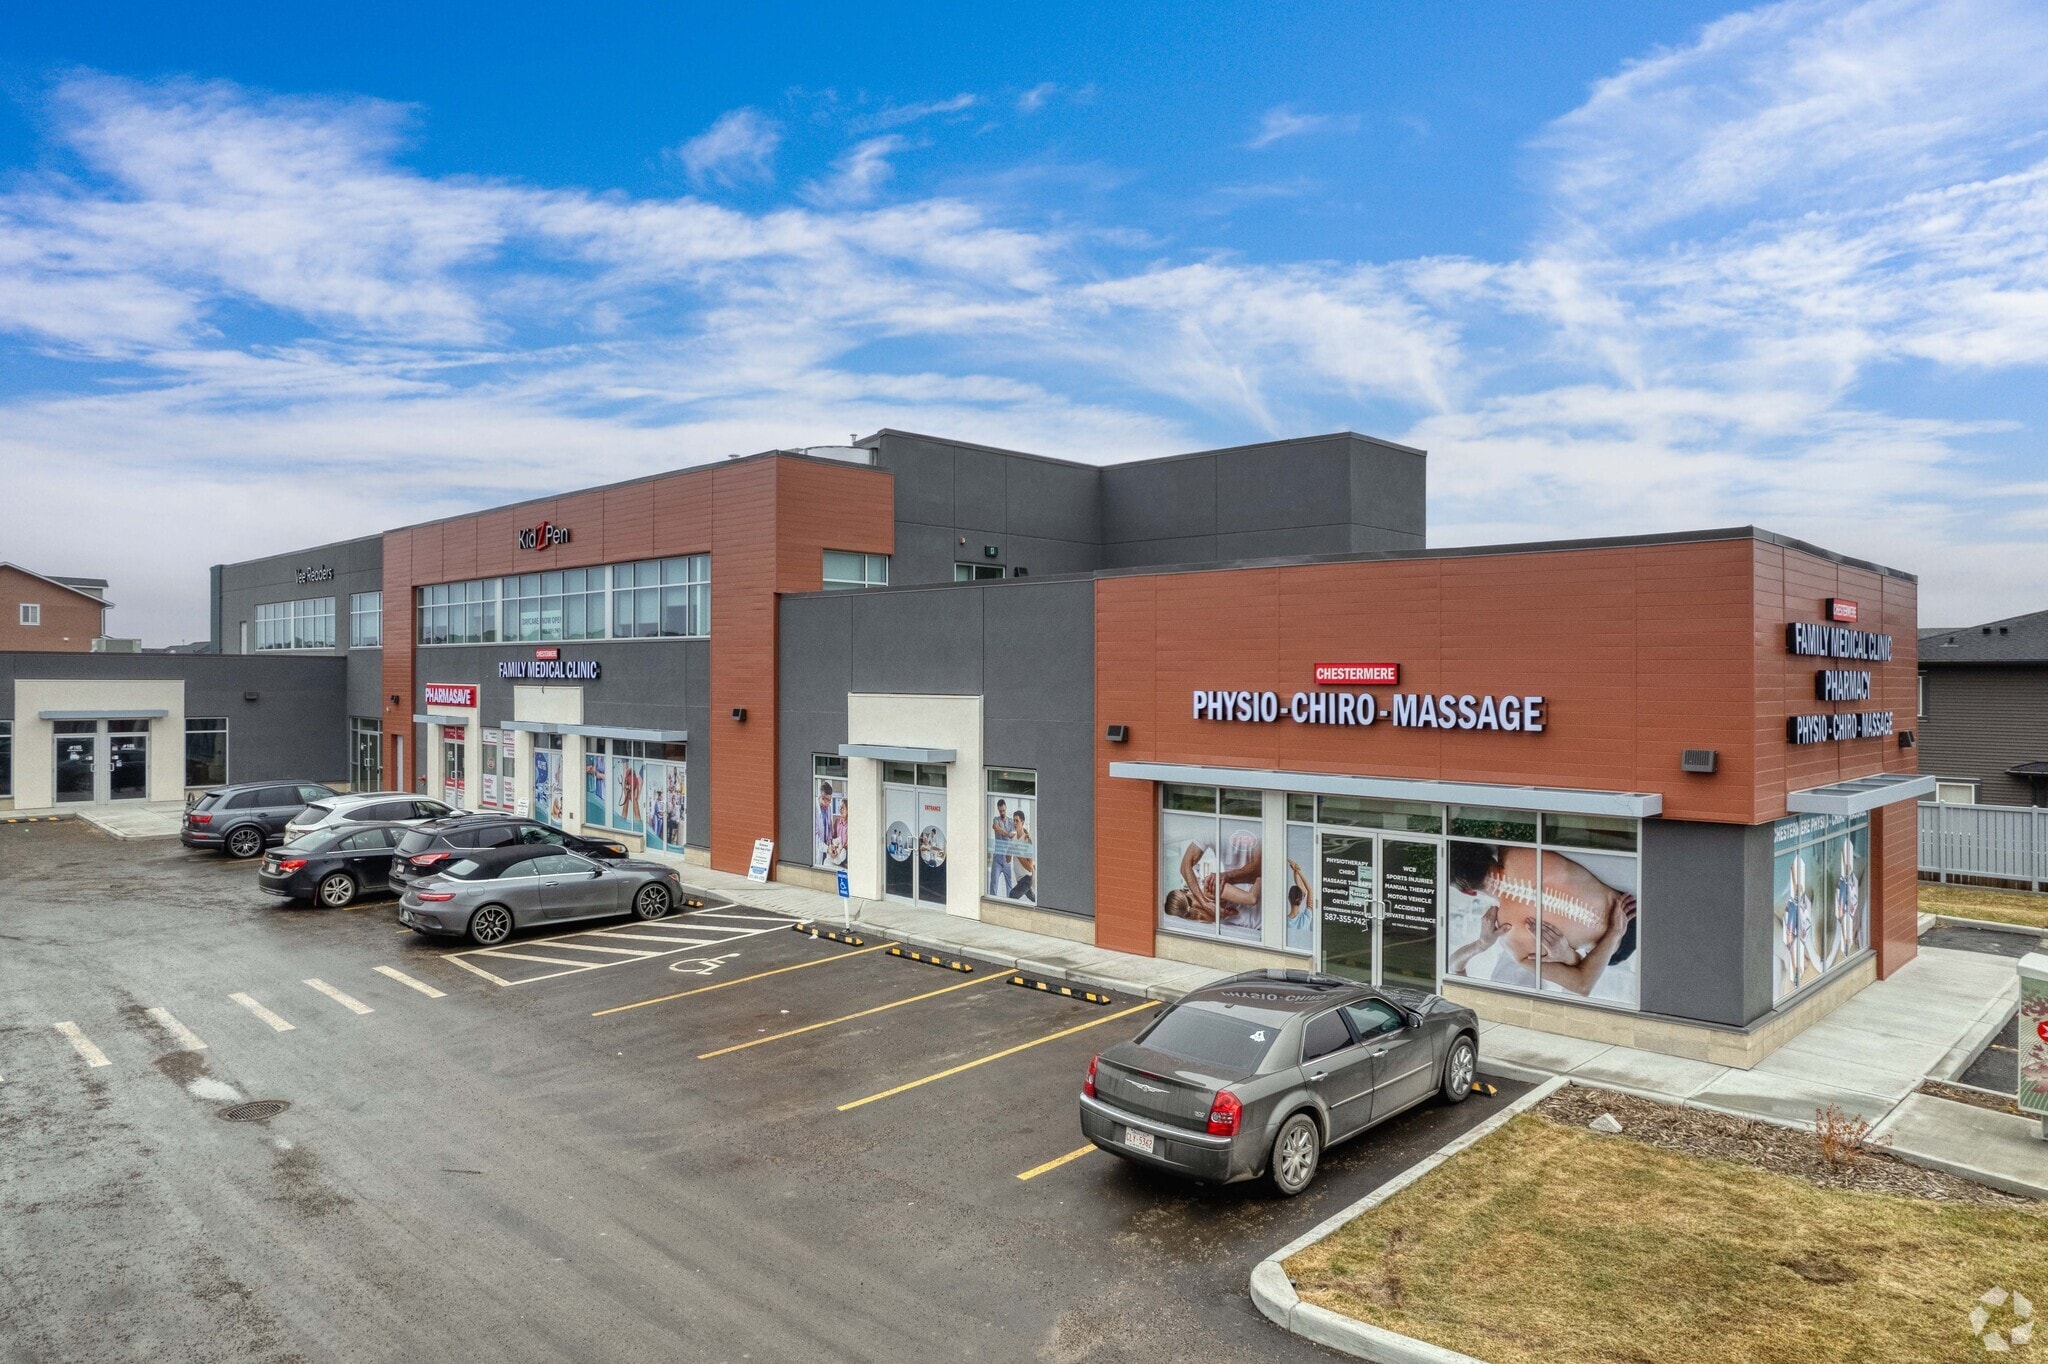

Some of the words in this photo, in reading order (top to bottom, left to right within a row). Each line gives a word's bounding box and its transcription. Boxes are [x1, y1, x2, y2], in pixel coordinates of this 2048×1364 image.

[1795, 623, 1830, 655] FAMILY
[1831, 627, 1868, 660] MEDICAL
[1868, 633, 1892, 662] CLINIC
[499, 661, 526, 678] FAMILY
[527, 661, 565, 678] MEDICAL
[566, 661, 597, 679] CLINIC
[1316, 667, 1395, 680] CHESTERMERE
[1825, 670, 1871, 701] PHARMACY
[425, 687, 471, 705] PHARMASAVE
[1861, 711, 1893, 738] MASSAGE
[1326, 857, 1368, 866] PHYSIOTHERAPY
[1323, 877, 1347, 885] MASSAGE
[1408, 877, 1433, 885] INJURIES
[1385, 883, 1408, 891] MANUAL
[1409, 886, 1435, 894] THERAPY
[1332, 898, 1363, 907] ORTHOTICS
[1408, 896, 1432, 904] VEHICLE
[1323, 906, 1351, 914] COMPRESSION
[1394, 904, 1425, 913] ACCIDENTS
[1384, 912, 1404, 920] PRIVATE
[1405, 915, 1436, 924] INSURANCE
